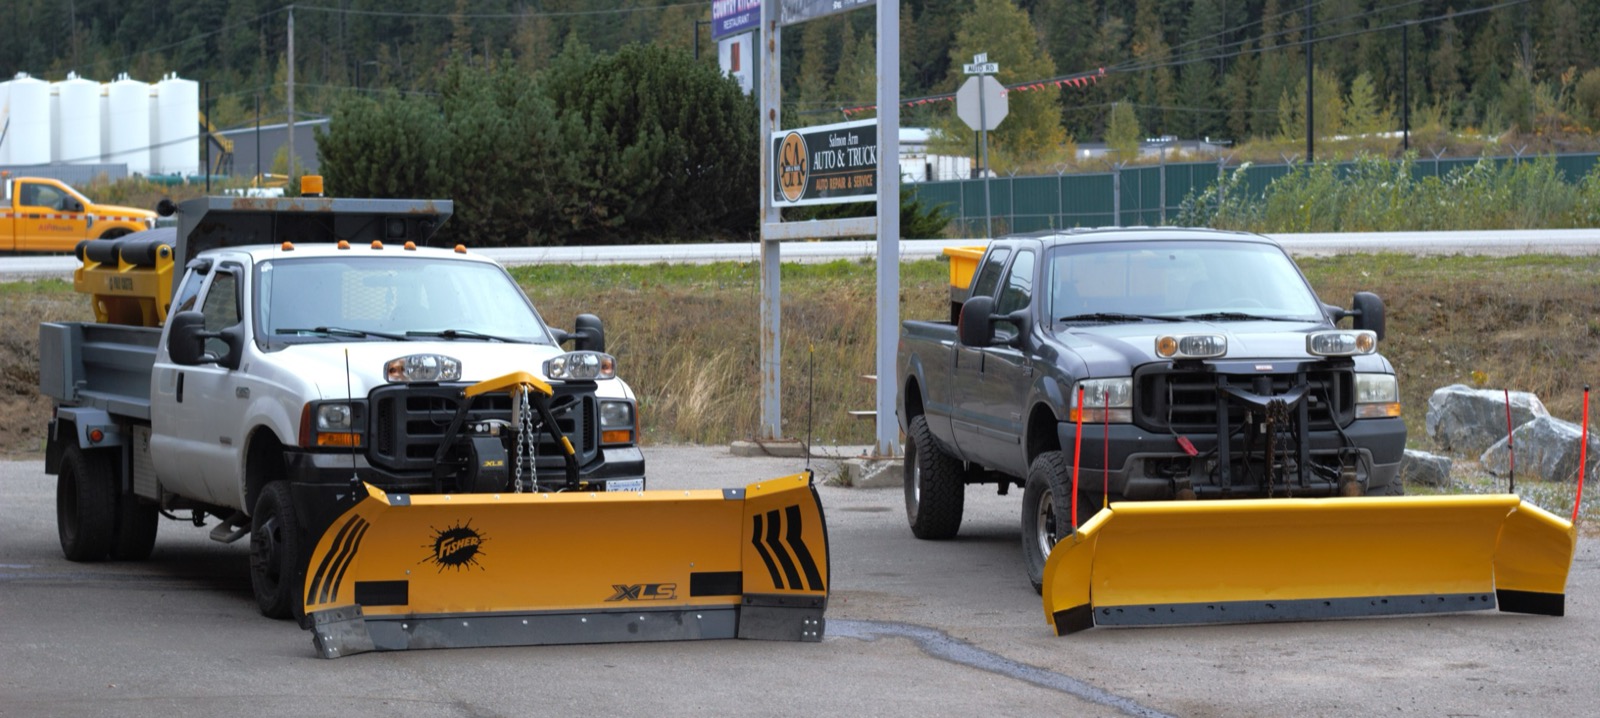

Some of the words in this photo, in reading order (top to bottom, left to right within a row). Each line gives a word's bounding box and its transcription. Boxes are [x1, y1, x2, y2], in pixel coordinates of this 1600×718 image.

[723, 13, 750, 30] RESTAURANT
[985, 64, 995, 72] RD
[829, 132, 847, 147] Salmon
[847, 131, 859, 146] Arm
[813, 150, 836, 170] AUTO
[837, 149, 845, 167] &
[847, 145, 877, 166] TRUCK
[816, 179, 828, 191] AUTO
[829, 177, 846, 190] REPAIR
[847, 176, 852, 189] &
[853, 174, 873, 187] SERVICE
[438, 536, 479, 559] FISHER
[604, 583, 677, 602] XLS
